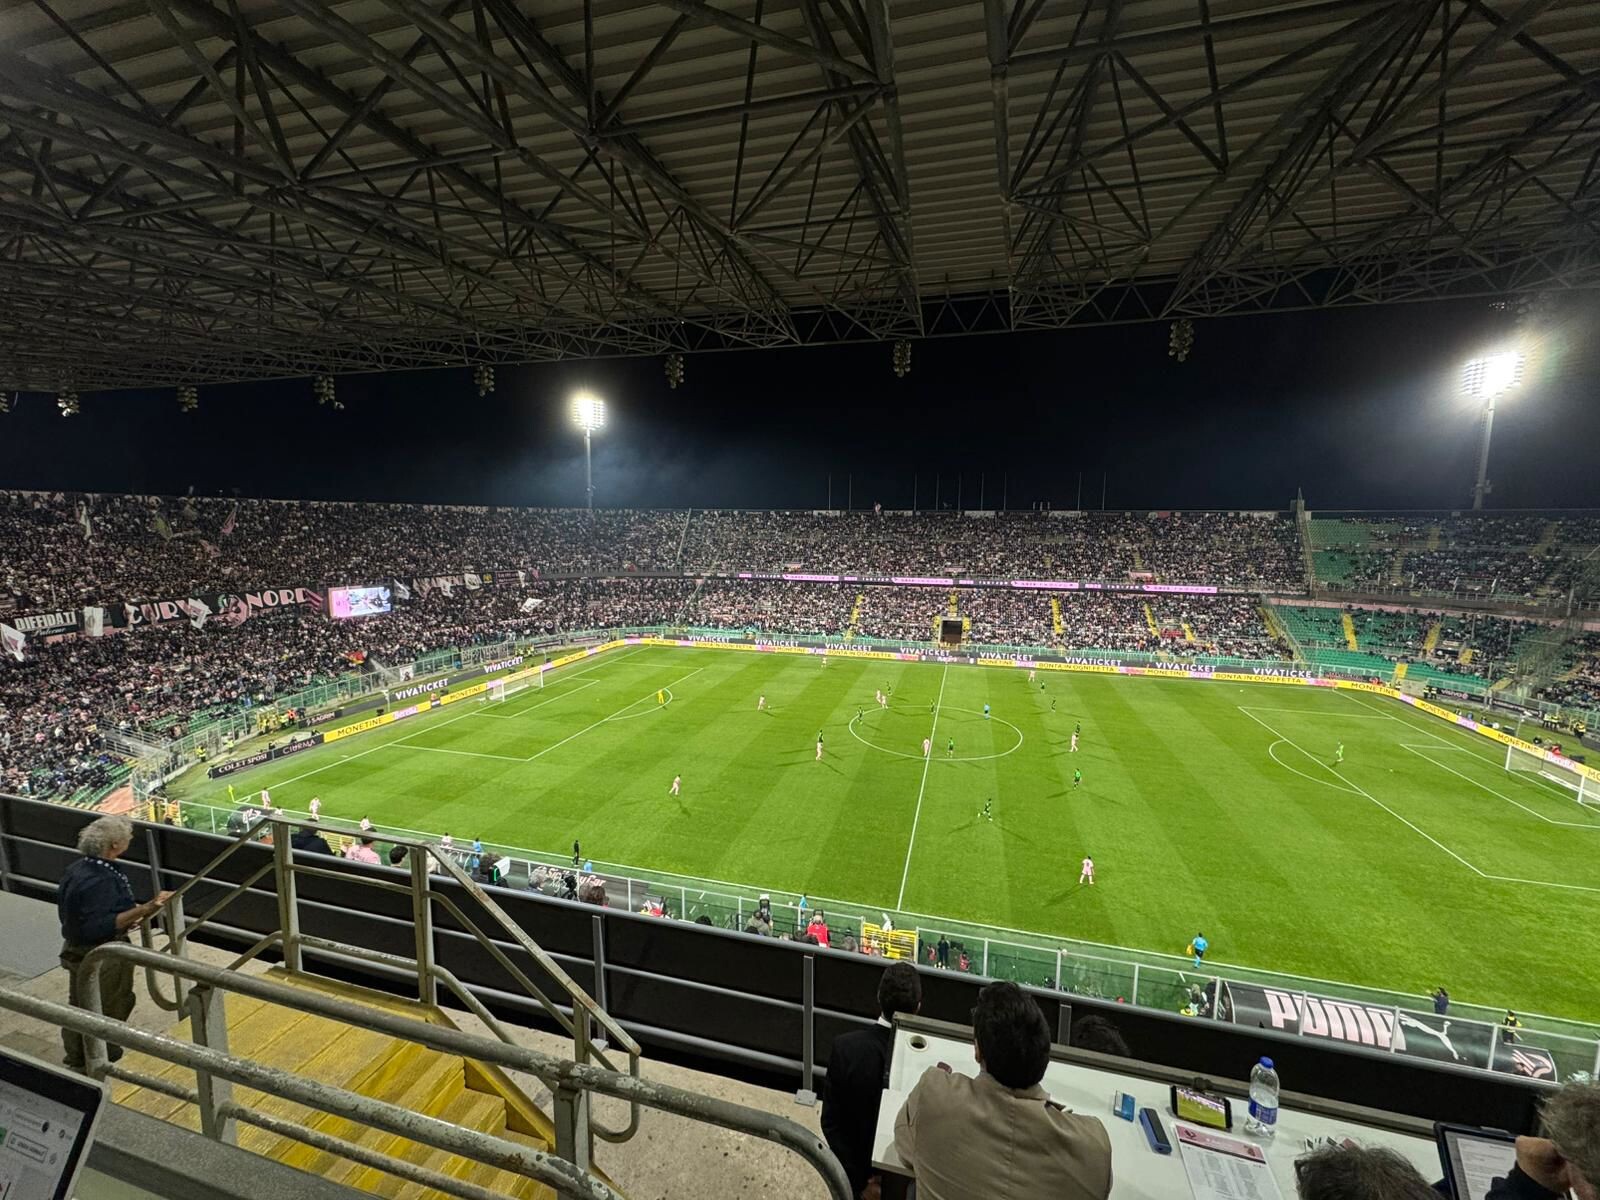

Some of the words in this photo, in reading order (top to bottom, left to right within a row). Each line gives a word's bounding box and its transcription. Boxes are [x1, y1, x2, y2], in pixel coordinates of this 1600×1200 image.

[14, 611, 77, 631] DIFFIDATI
[754, 639, 799, 647] VIVATICKET
[825, 643, 873, 651] VIVATICKET
[900, 647, 951, 657] VIVATICKET
[979, 652, 1033, 661] VIVATICKET
[484, 656, 524, 673] VIVATICKET
[1065, 656, 1122, 667] VIVATICKET
[1155, 662, 1217, 672] VIVATICKET
[395, 678, 449, 700] VIVATICKET
[1351, 683, 1395, 695] MONETINE
[1421, 702, 1449, 718] MONETINE
[338, 718, 382, 737] MONETINE
[1264, 990, 1406, 1050] PUMA
